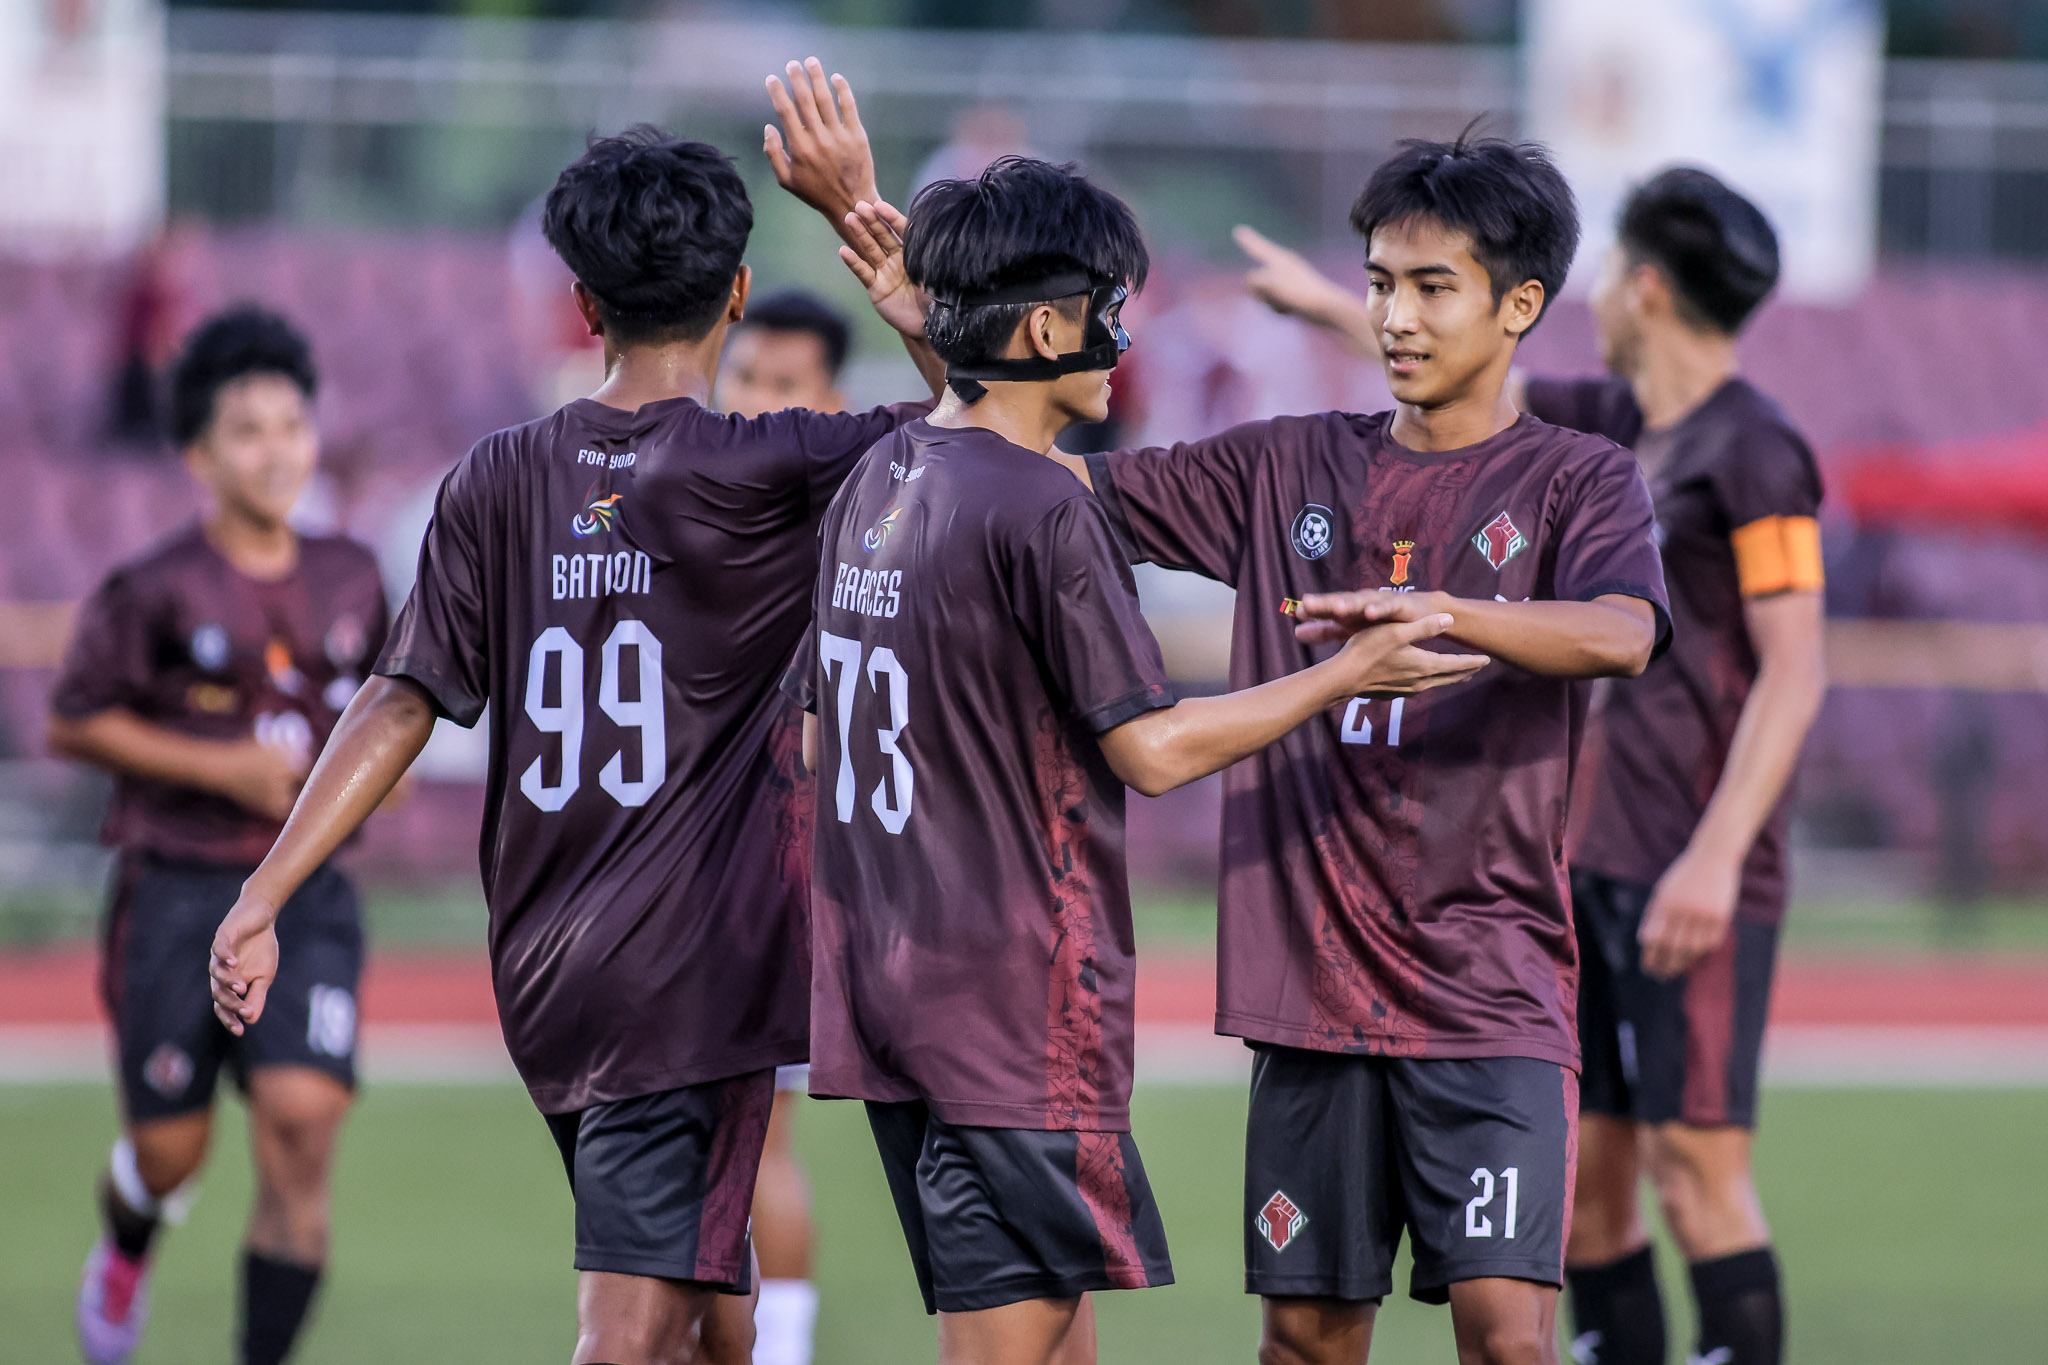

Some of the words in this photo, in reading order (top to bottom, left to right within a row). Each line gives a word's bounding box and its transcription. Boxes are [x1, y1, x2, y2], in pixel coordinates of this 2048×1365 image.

[577, 449, 606, 467] FOR
[552, 550, 651, 600] BATION
[832, 561, 903, 618] GARCES
[520, 619, 667, 812] 99
[820, 629, 914, 835] 73
[1465, 1166, 1519, 1239] 21
